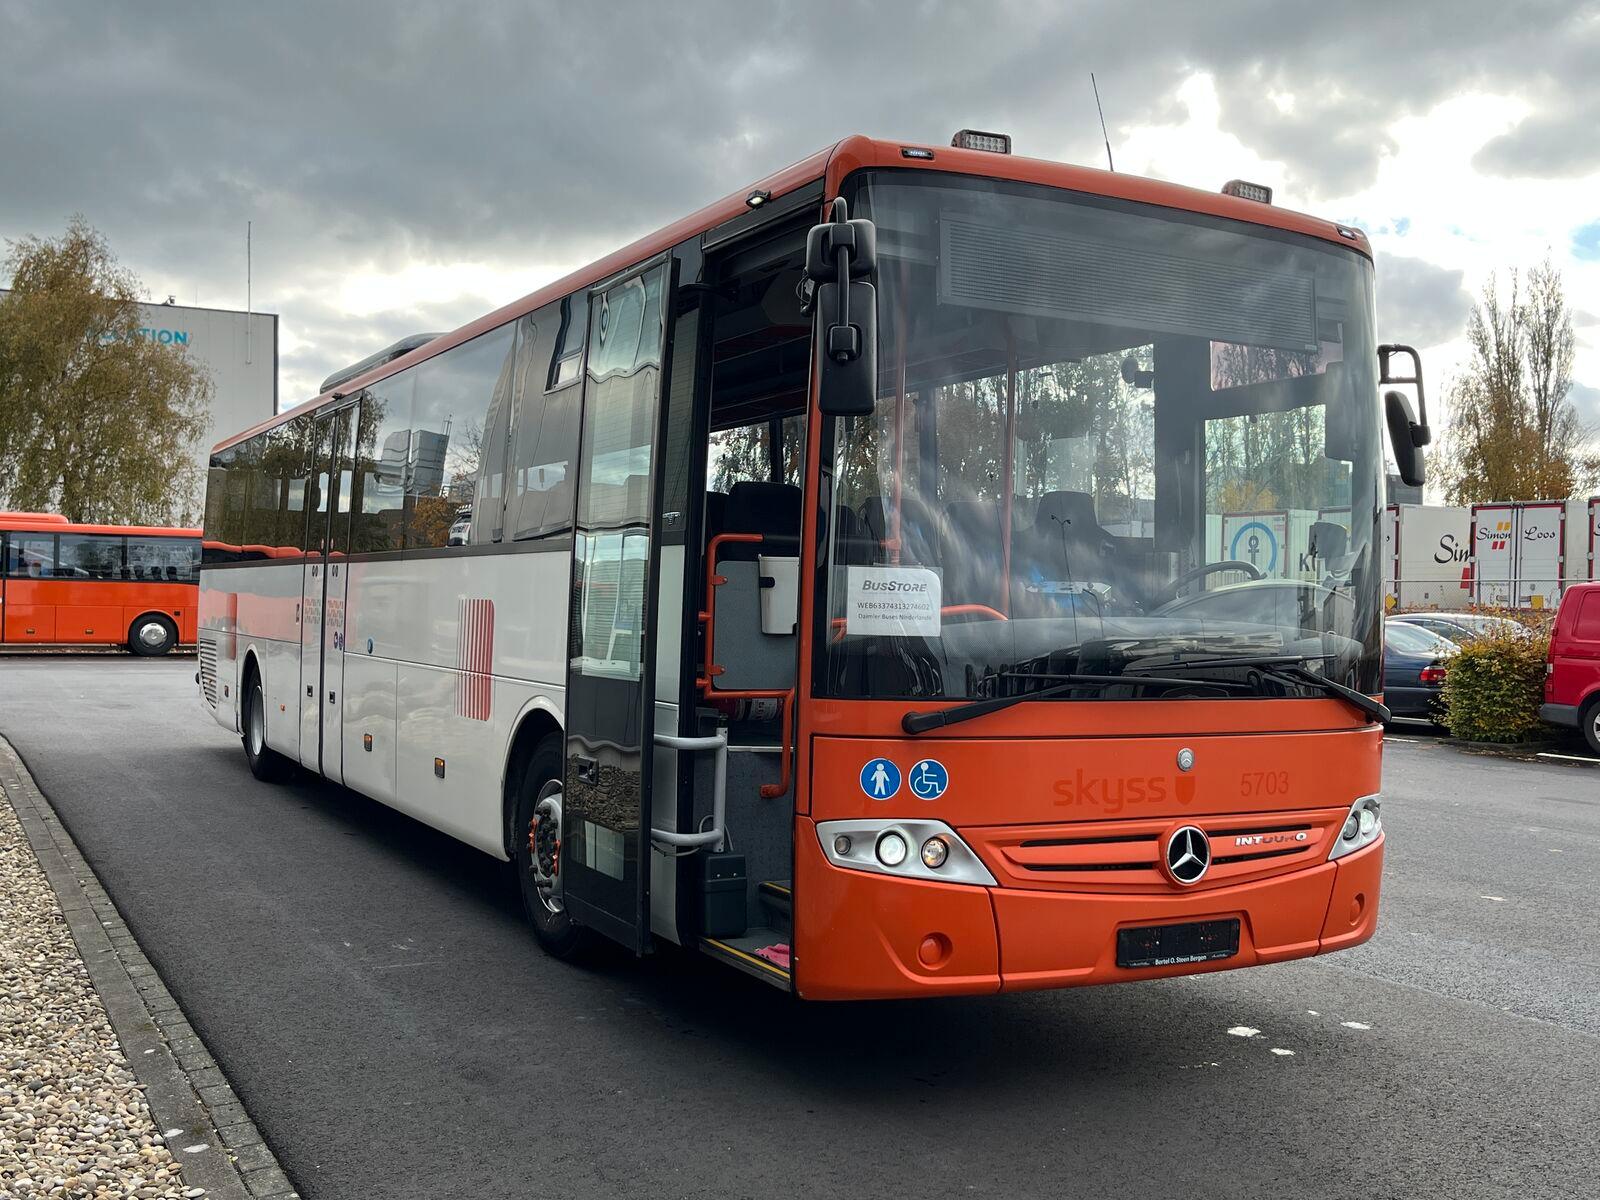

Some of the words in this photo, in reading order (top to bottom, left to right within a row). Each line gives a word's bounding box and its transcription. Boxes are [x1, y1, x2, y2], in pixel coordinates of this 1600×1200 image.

[1476, 527, 1511, 541] Simon
[1524, 526, 1556, 541] Loos
[1053, 768, 1167, 814] skyss
[1240, 771, 1289, 797] 5703
[1155, 957, 1170, 966] Bertel
[1190, 954, 1207, 963] Bergen
